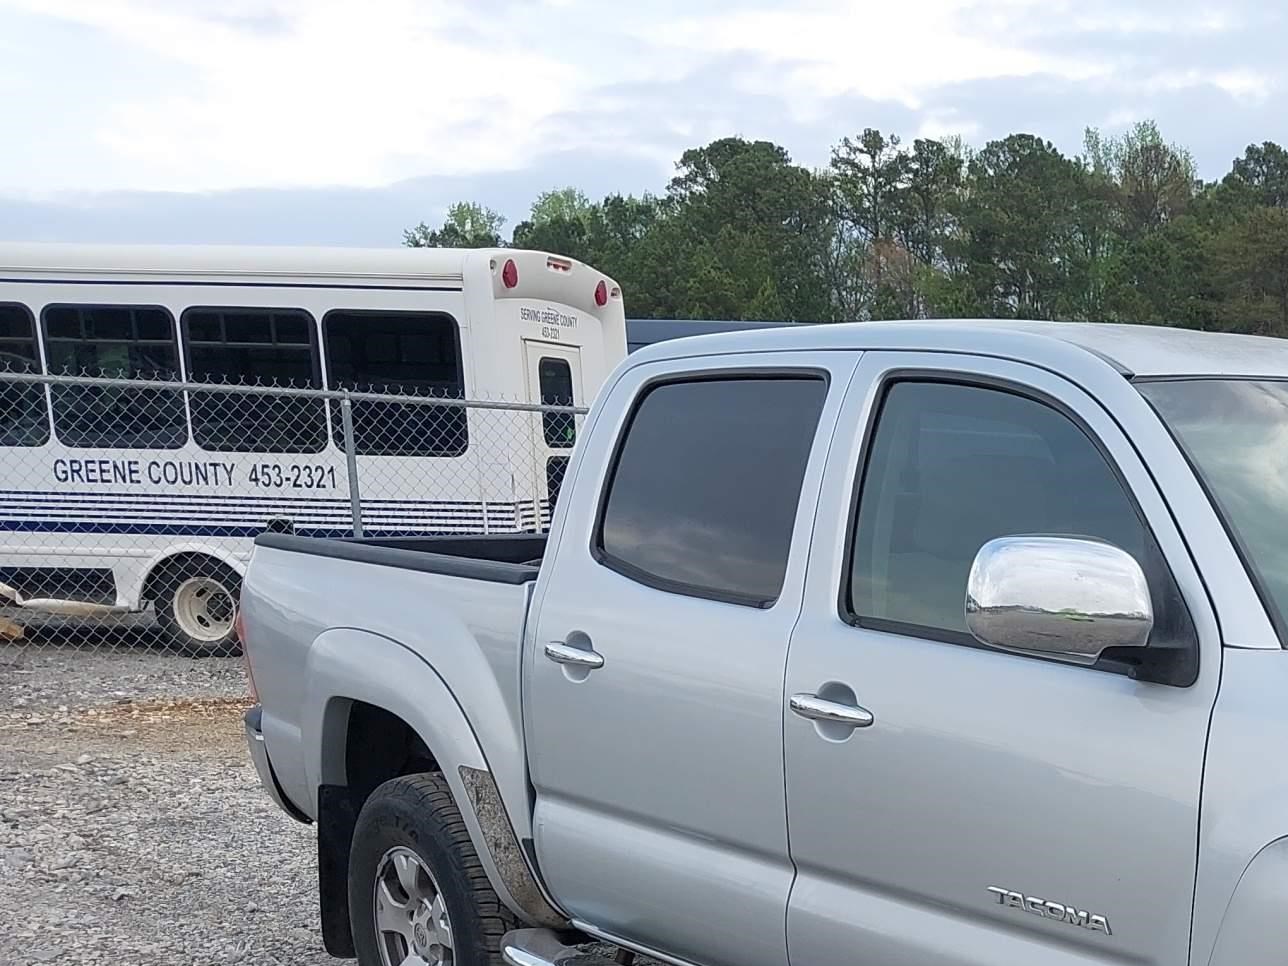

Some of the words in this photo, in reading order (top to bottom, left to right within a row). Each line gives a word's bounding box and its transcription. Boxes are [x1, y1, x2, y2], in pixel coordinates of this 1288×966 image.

[520, 307, 541, 322] SERVING
[541, 311, 560, 326] GREENE
[560, 314, 578, 329] COUNTY
[53, 458, 142, 484] GREENE
[147, 460, 236, 487] COUNTY
[248, 463, 338, 489] 453-2321
[986, 884, 1112, 936] TACOMA
